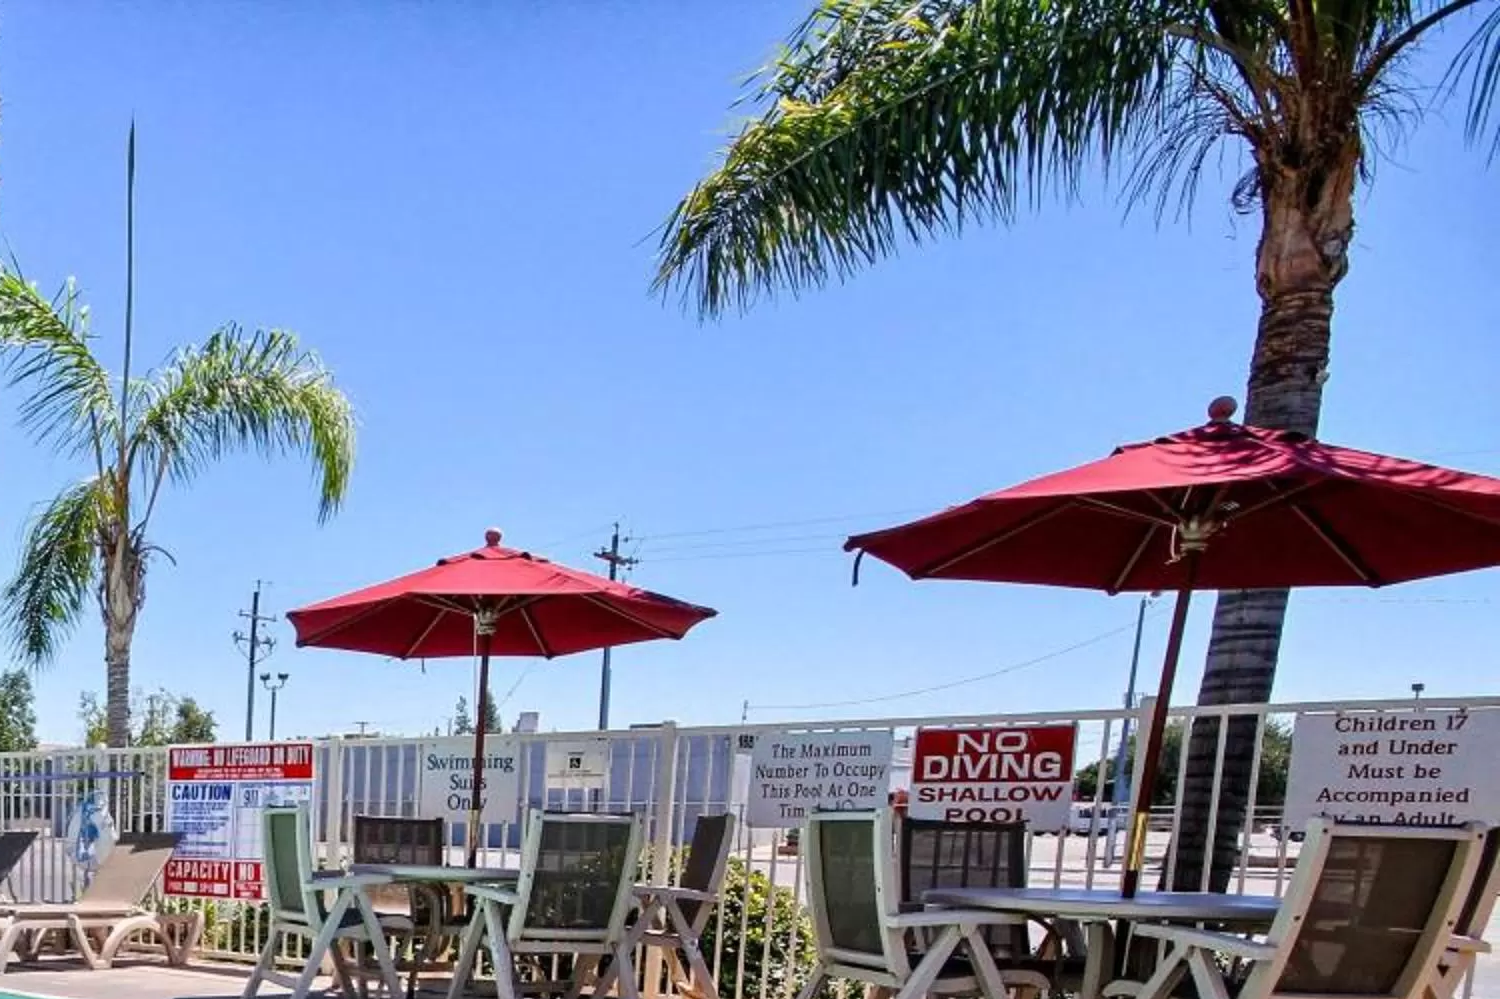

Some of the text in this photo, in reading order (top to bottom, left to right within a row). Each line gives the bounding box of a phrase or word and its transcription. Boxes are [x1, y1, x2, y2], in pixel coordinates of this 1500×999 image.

[1335, 714, 1469, 732] Children 17
[772, 743, 871, 758] The Maximum
[957, 731, 1029, 753] NO
[1337, 739, 1459, 755] and Under
[756, 762, 887, 780] Number To Occupy
[923, 751, 1061, 780] DIVING
[1348, 763, 1441, 779] Must be
[450, 773, 487, 791] Suis
[761, 781, 876, 799] This Pool At One
[172, 784, 232, 800] CAUTION
[918, 786, 1063, 802] SHALLOW
[1316, 787, 1469, 806] Accompanied
[447, 794, 488, 811] Ony
[167, 861, 229, 880] CAPACITY
